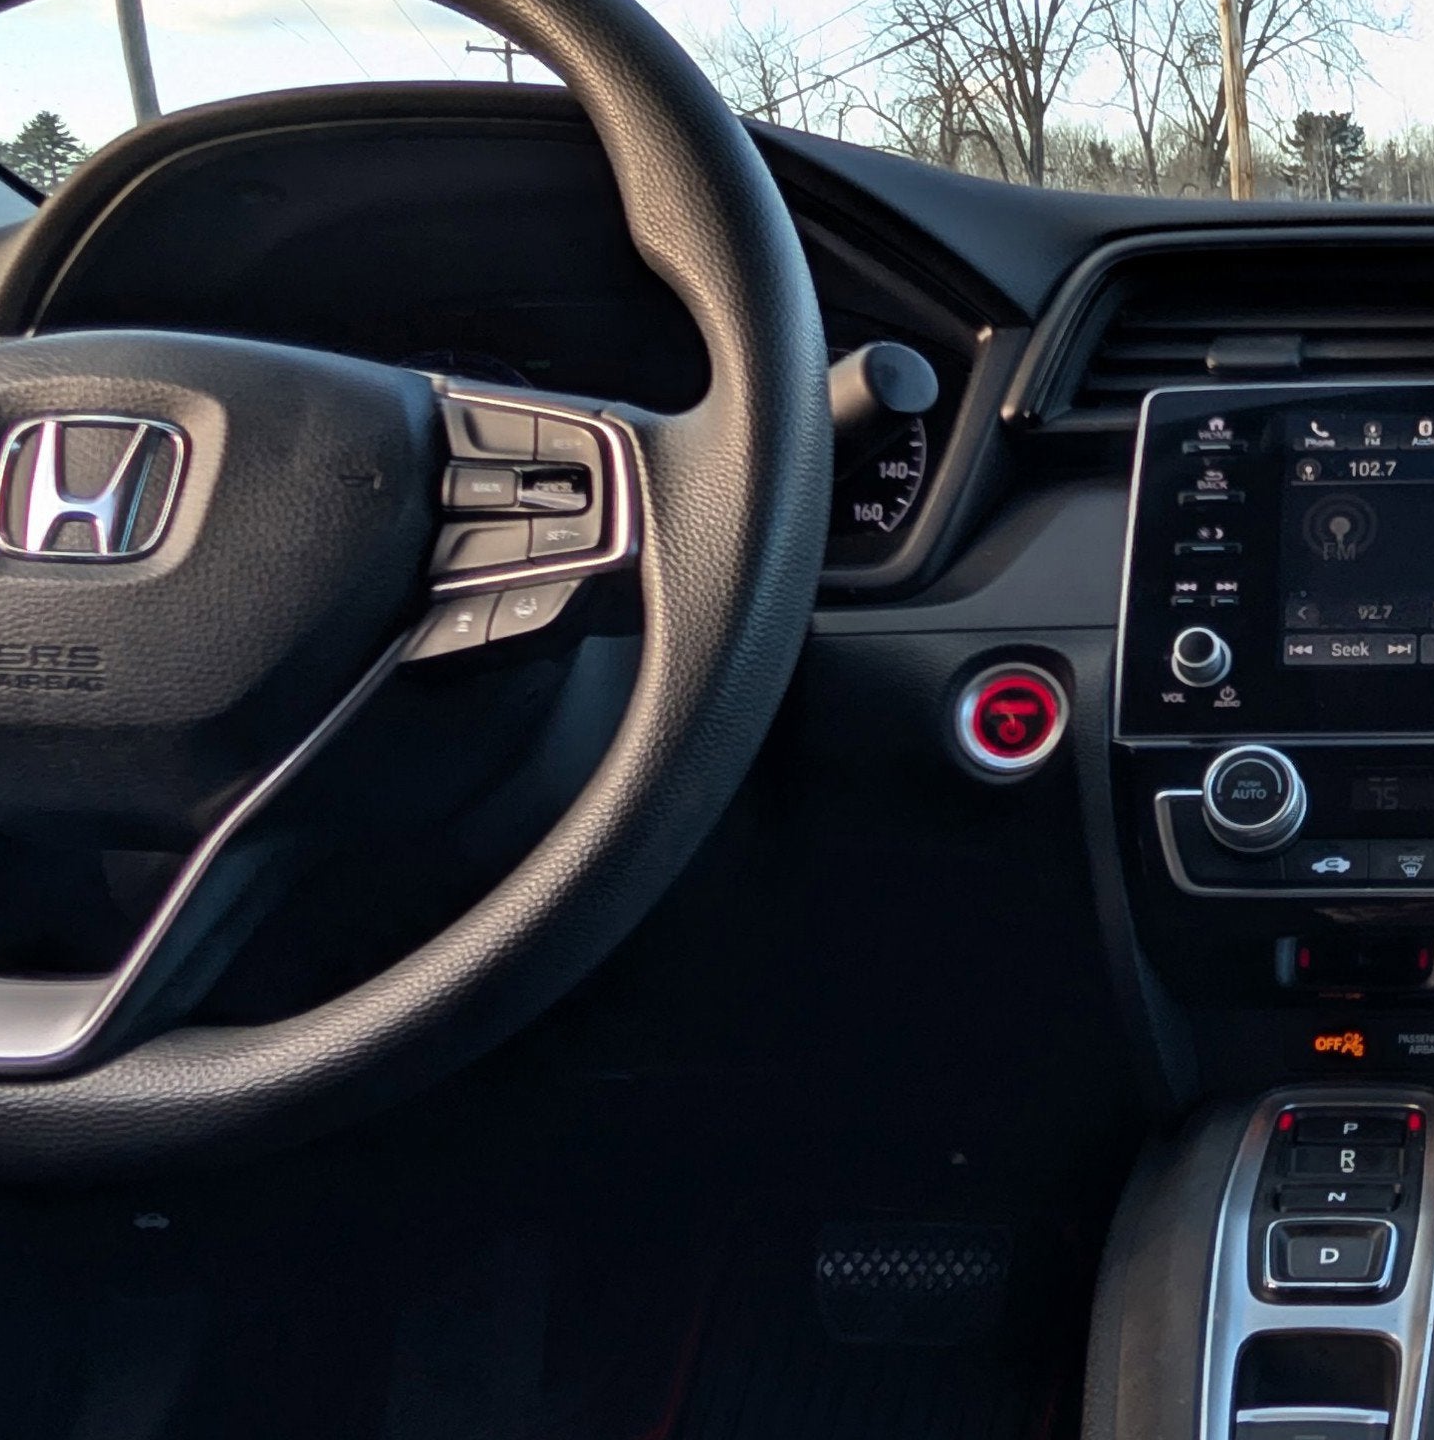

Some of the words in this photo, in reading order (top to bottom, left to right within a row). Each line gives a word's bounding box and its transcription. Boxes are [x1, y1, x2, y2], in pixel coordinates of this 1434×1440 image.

[879, 461, 908, 479] 140
[1348, 460, 1398, 478] 102.7
[853, 502, 884, 522] 160
[1323, 541, 1357, 561] FM
[1357, 604, 1394, 621] 92.7
[1331, 641, 1370, 658] Seek
[1161, 692, 1186, 703] VOL
[1231, 789, 1267, 800] AUTO
[1315, 1036, 1343, 1051] OFF
[1343, 1122, 1358, 1135] P
[1340, 1149, 1356, 1169] R
[1327, 1192, 1347, 1202] N
[1320, 1247, 1340, 1265] D
